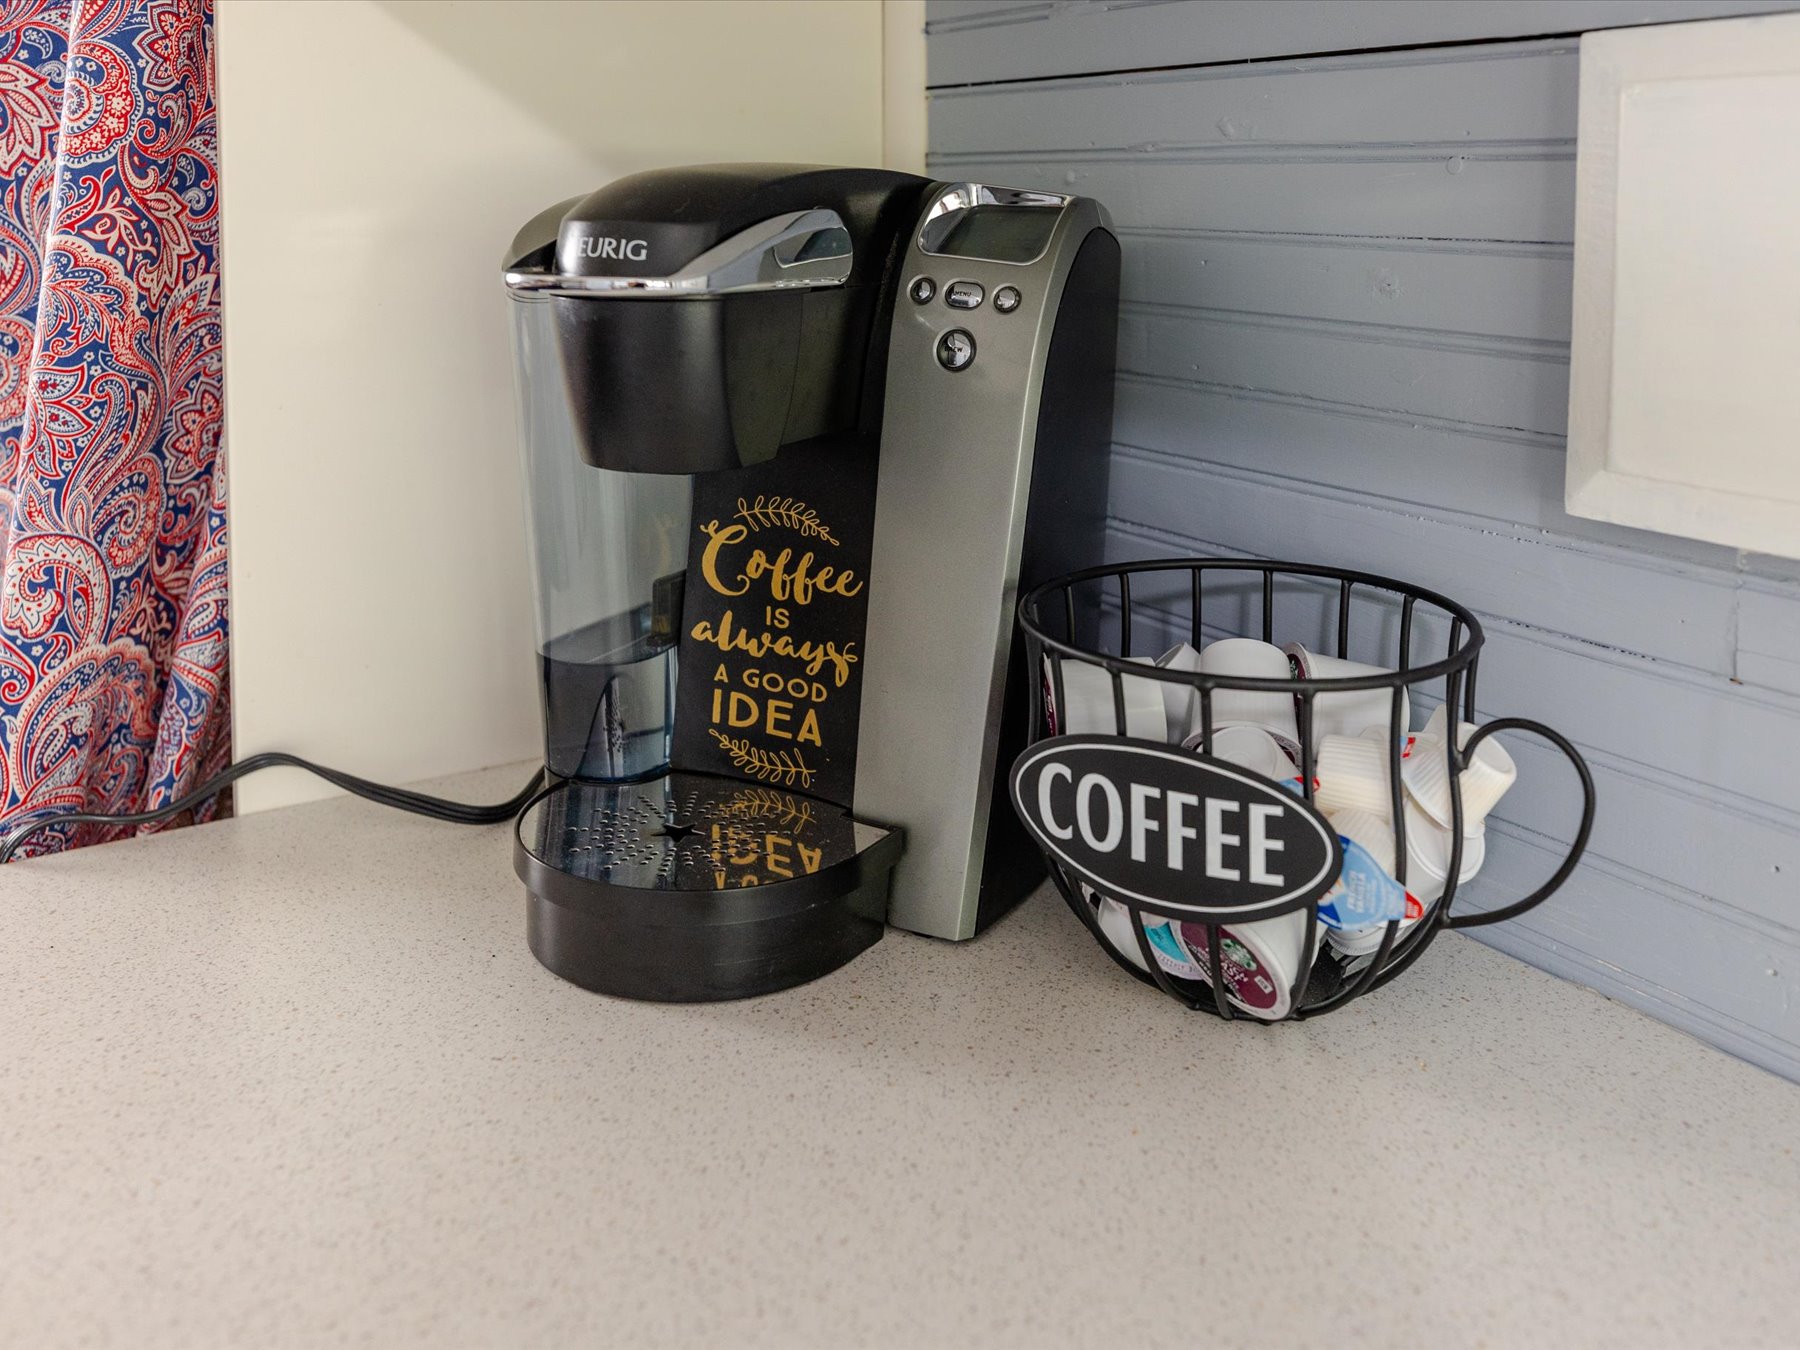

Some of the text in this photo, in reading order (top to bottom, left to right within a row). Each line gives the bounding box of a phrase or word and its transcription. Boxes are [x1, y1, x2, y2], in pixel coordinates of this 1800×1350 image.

[574, 236, 648, 261] EURIG
[701, 520, 863, 605] Coffee
[766, 606, 790, 628] IS
[691, 610, 858, 687] always
[714, 664, 828, 702] A GOOD
[711, 688, 822, 747] IDEA
[1038, 762, 1284, 888] COFFEE
